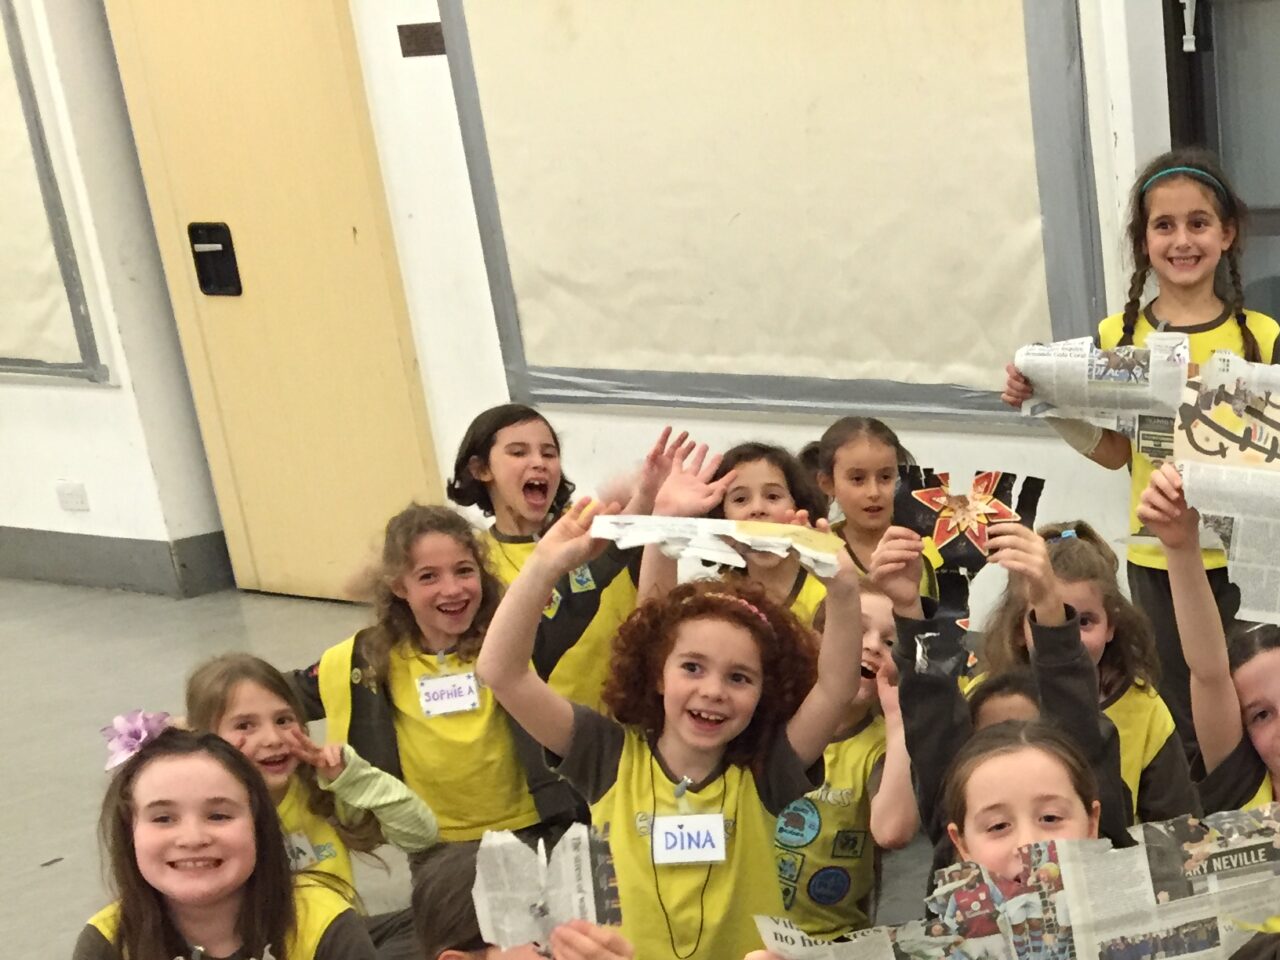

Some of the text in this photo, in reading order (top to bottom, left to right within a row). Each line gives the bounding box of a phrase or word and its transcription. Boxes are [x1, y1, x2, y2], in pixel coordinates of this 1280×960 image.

[424, 685, 475, 702] SOPHIE A
[664, 828, 716, 850] DINA
[1213, 848, 1267, 871] NEVILLE
[773, 931, 796, 945] no
